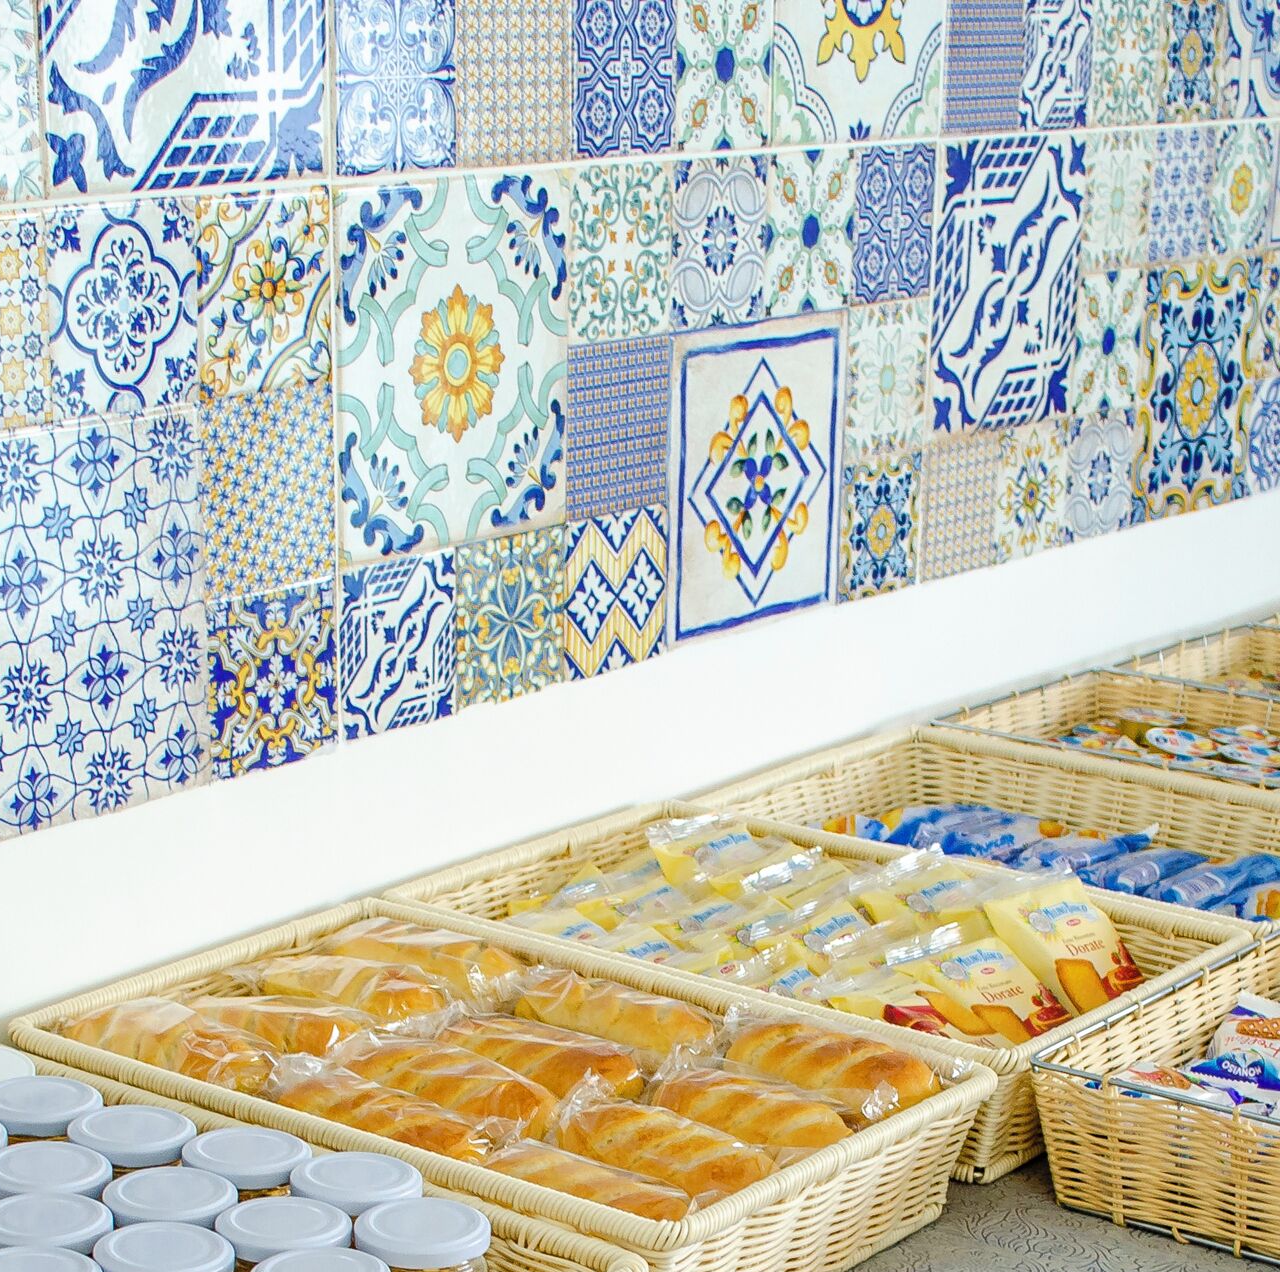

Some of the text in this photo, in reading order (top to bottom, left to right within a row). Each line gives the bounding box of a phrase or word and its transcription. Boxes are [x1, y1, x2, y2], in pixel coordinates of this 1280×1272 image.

[1065, 938, 1106, 957] Dorate
[981, 984, 1025, 1004] Dorate
[1221, 1058, 1263, 1080] MONVISO
